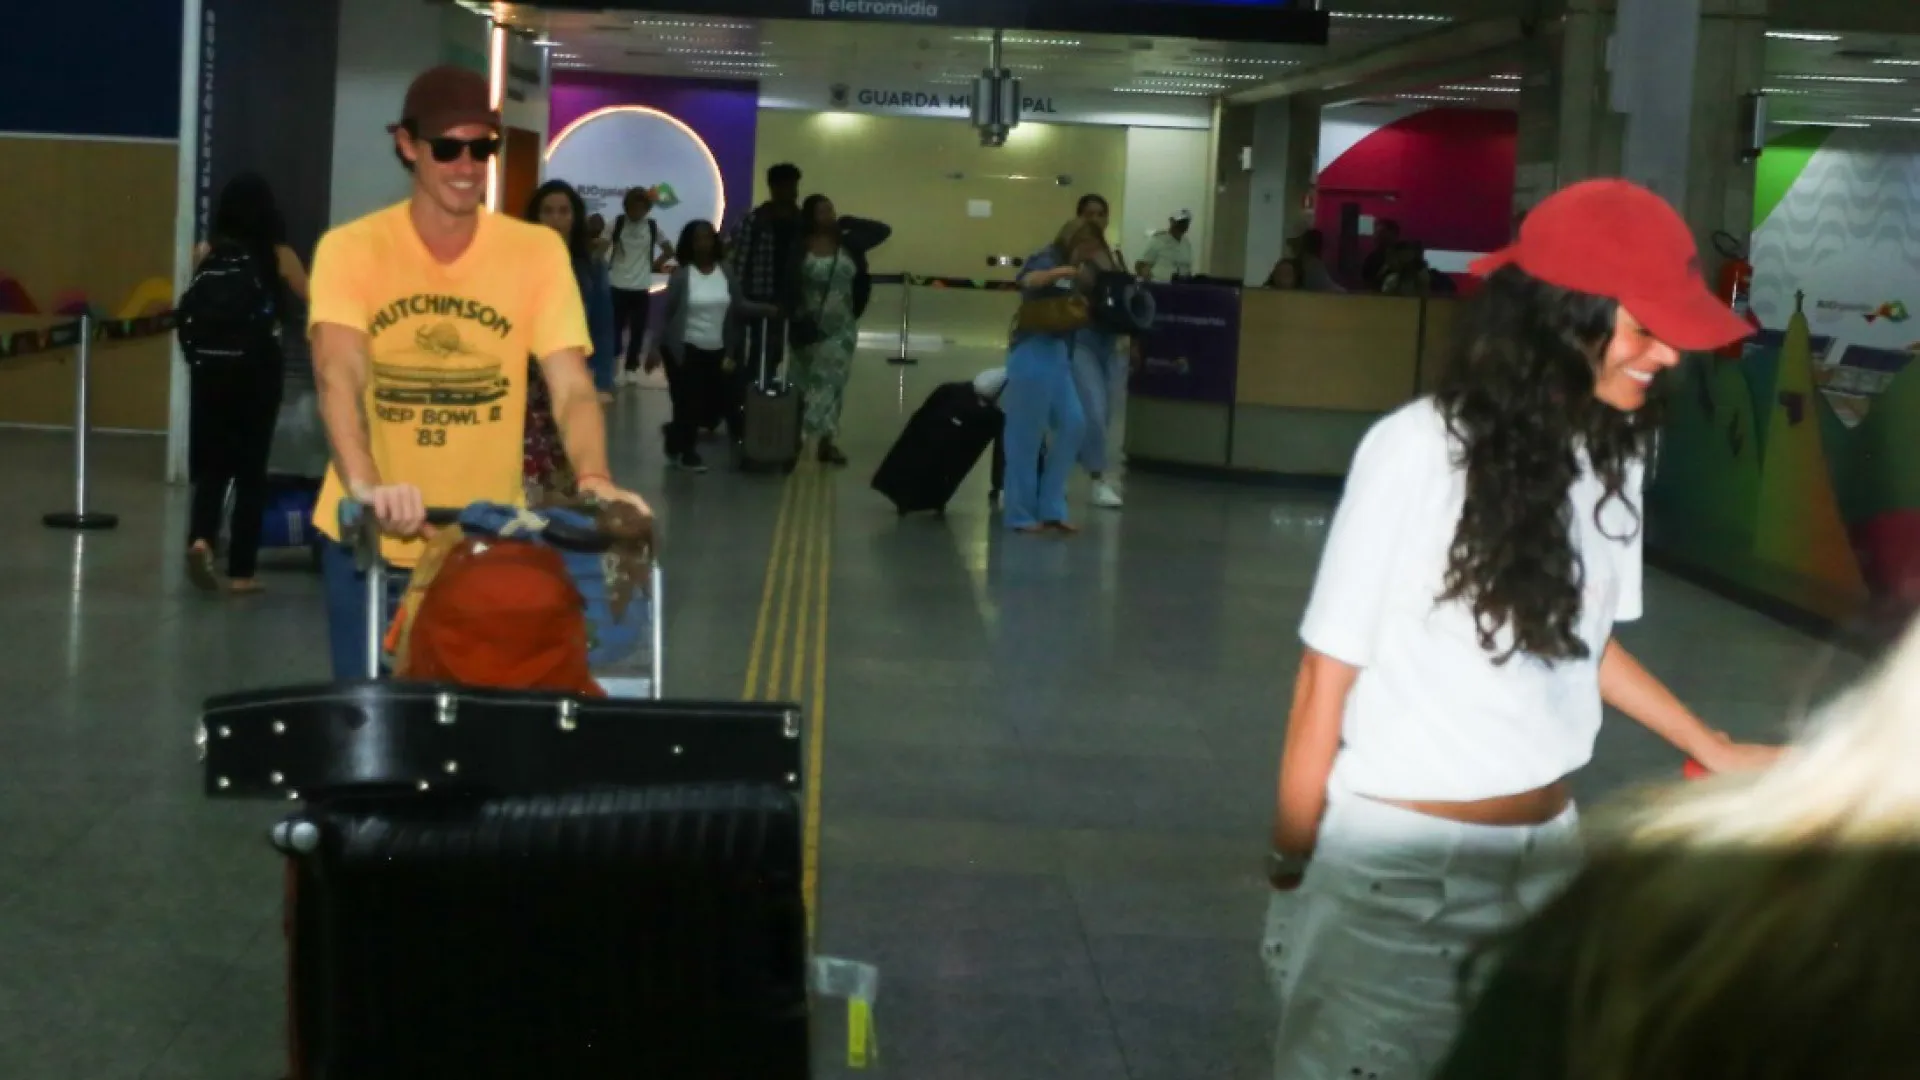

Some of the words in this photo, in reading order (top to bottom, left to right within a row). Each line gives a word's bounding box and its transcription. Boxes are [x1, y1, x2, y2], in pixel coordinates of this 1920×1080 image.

[857, 88, 940, 109] GUARDA
[368, 294, 512, 339] HUTCHINSON
[422, 409, 480, 426] BOWL
